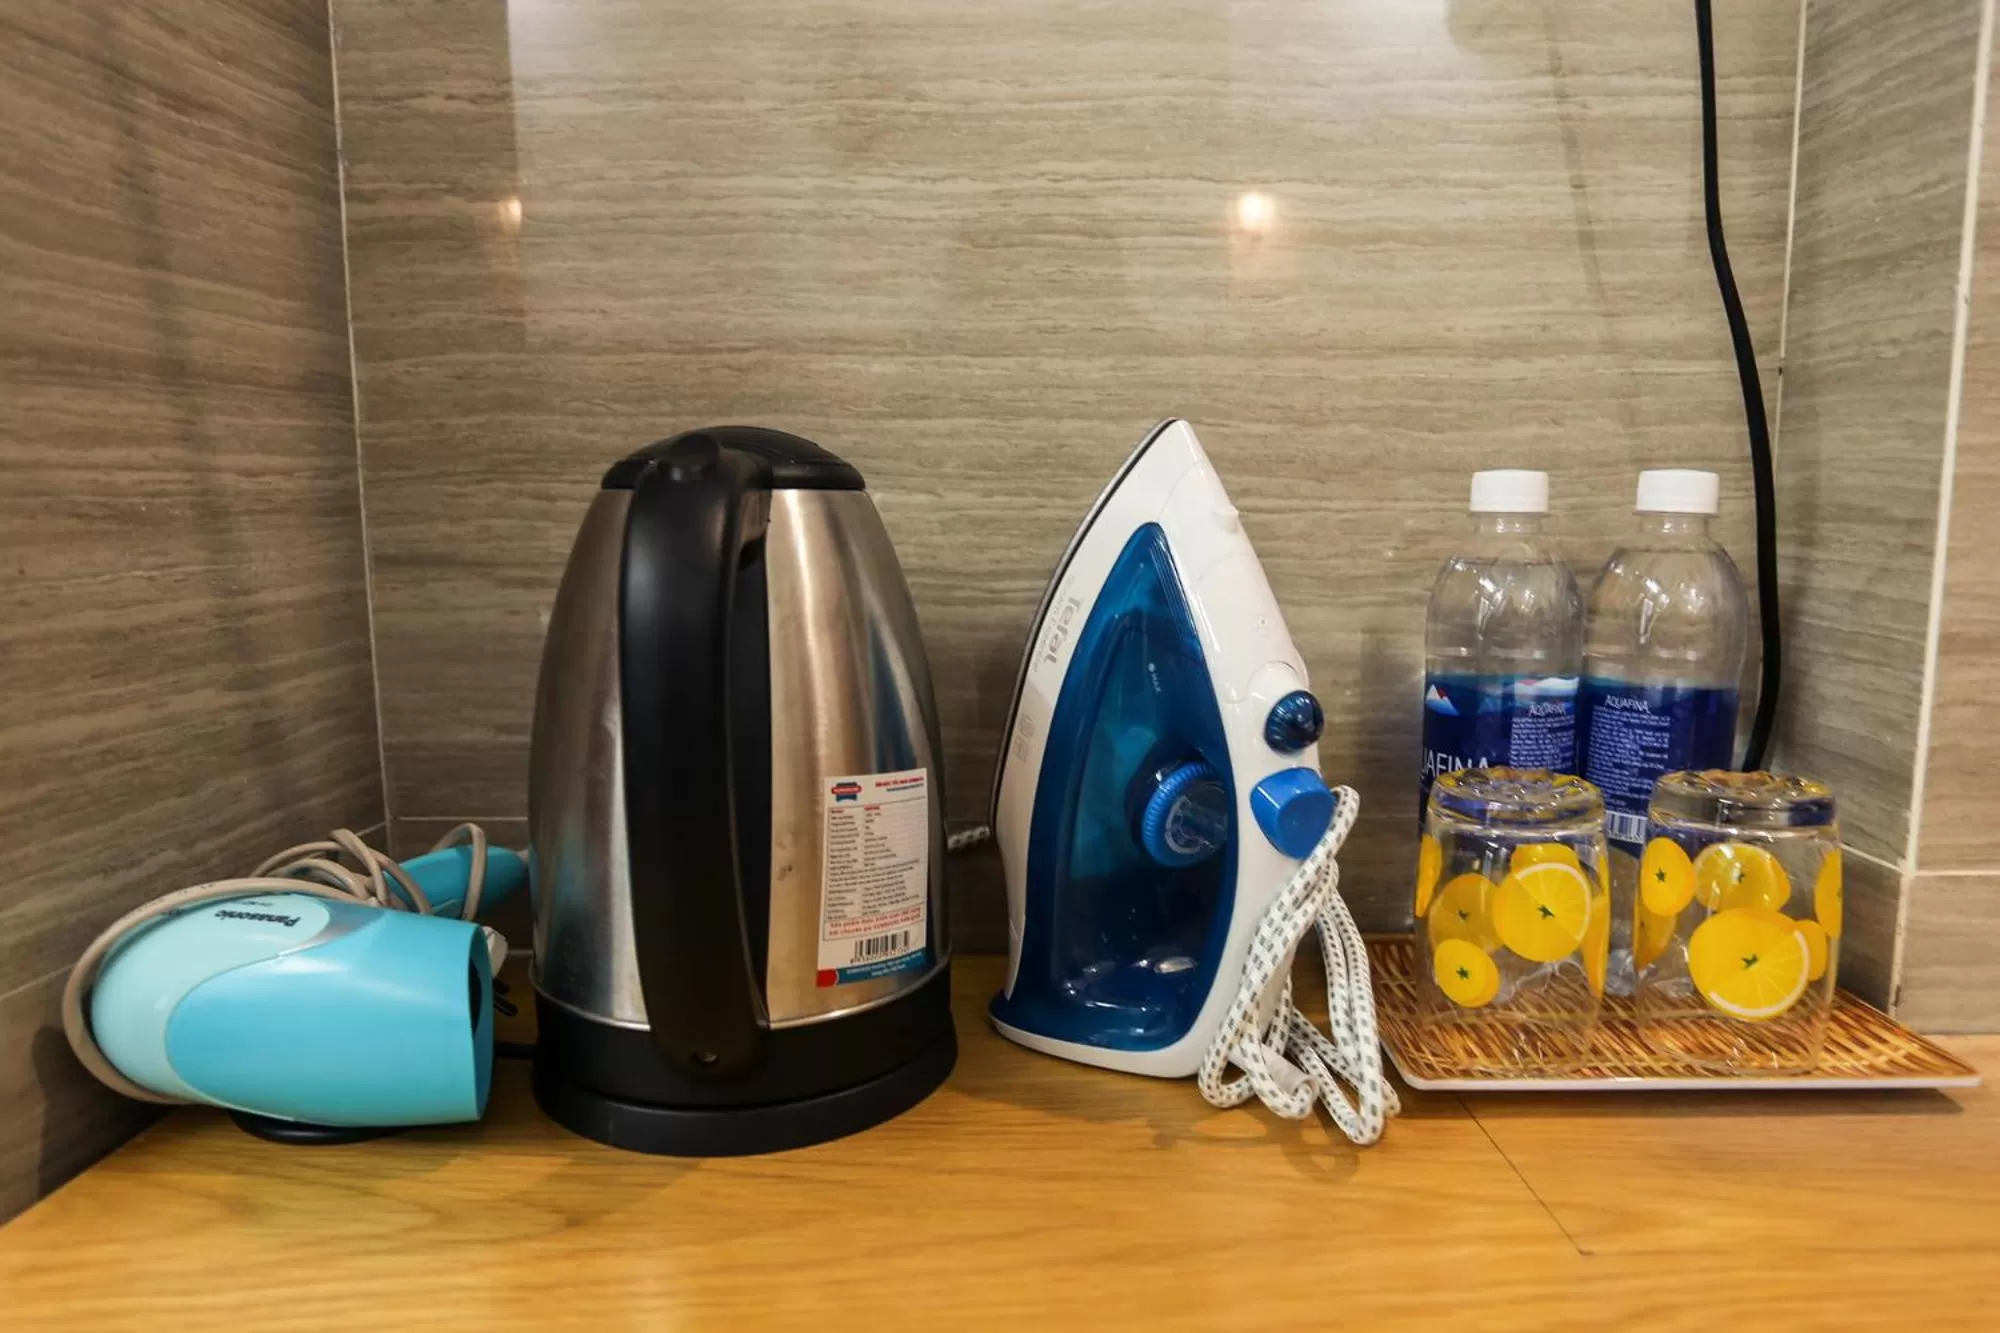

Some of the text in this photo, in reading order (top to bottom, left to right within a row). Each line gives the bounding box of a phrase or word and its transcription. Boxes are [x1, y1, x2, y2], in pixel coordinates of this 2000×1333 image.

[1043, 596, 1081, 665] Tefal
[1604, 694, 1651, 714] AQUAFINA
[213, 908, 302, 927] Panasonic
